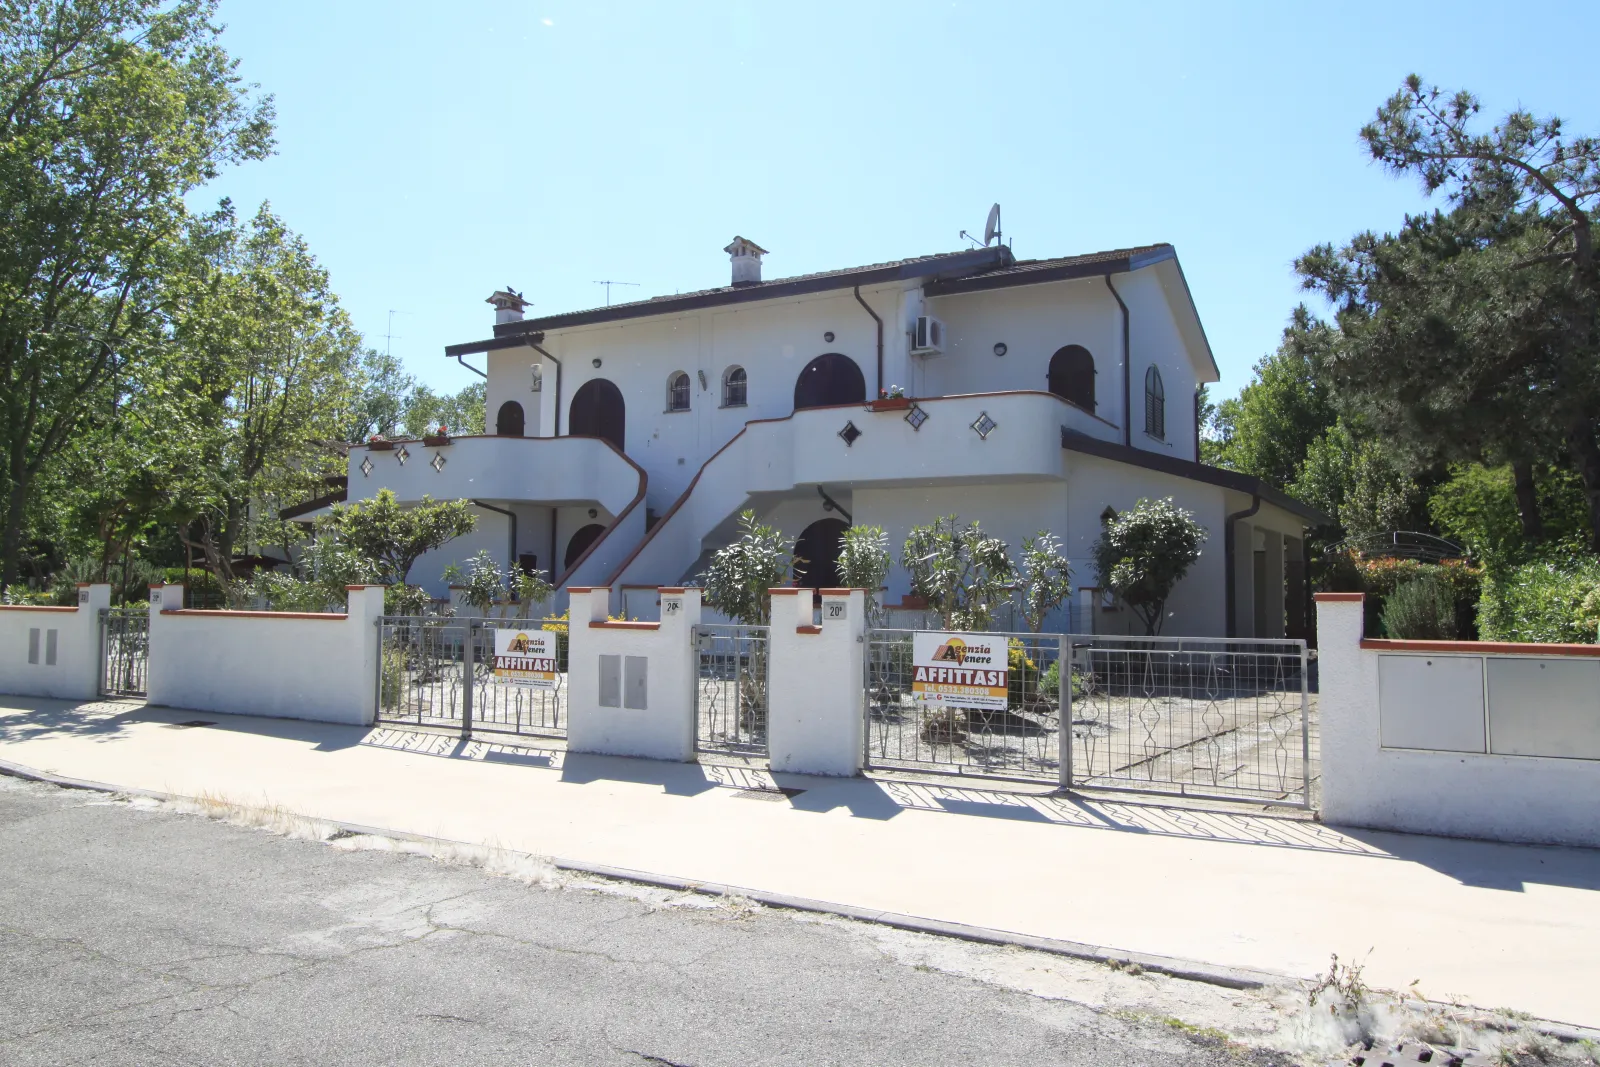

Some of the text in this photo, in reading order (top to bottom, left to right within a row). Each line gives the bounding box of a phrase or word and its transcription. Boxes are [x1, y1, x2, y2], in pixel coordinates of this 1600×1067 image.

[513, 638, 545, 651] Agenzia
[523, 645, 546, 656] Venere
[942, 644, 991, 660] Agenzia
[496, 656, 554, 672] AFFITTASI
[957, 654, 992, 667] Venere
[915, 666, 1005, 687] AFFITTASI
[923, 683, 936, 692] Tel.
